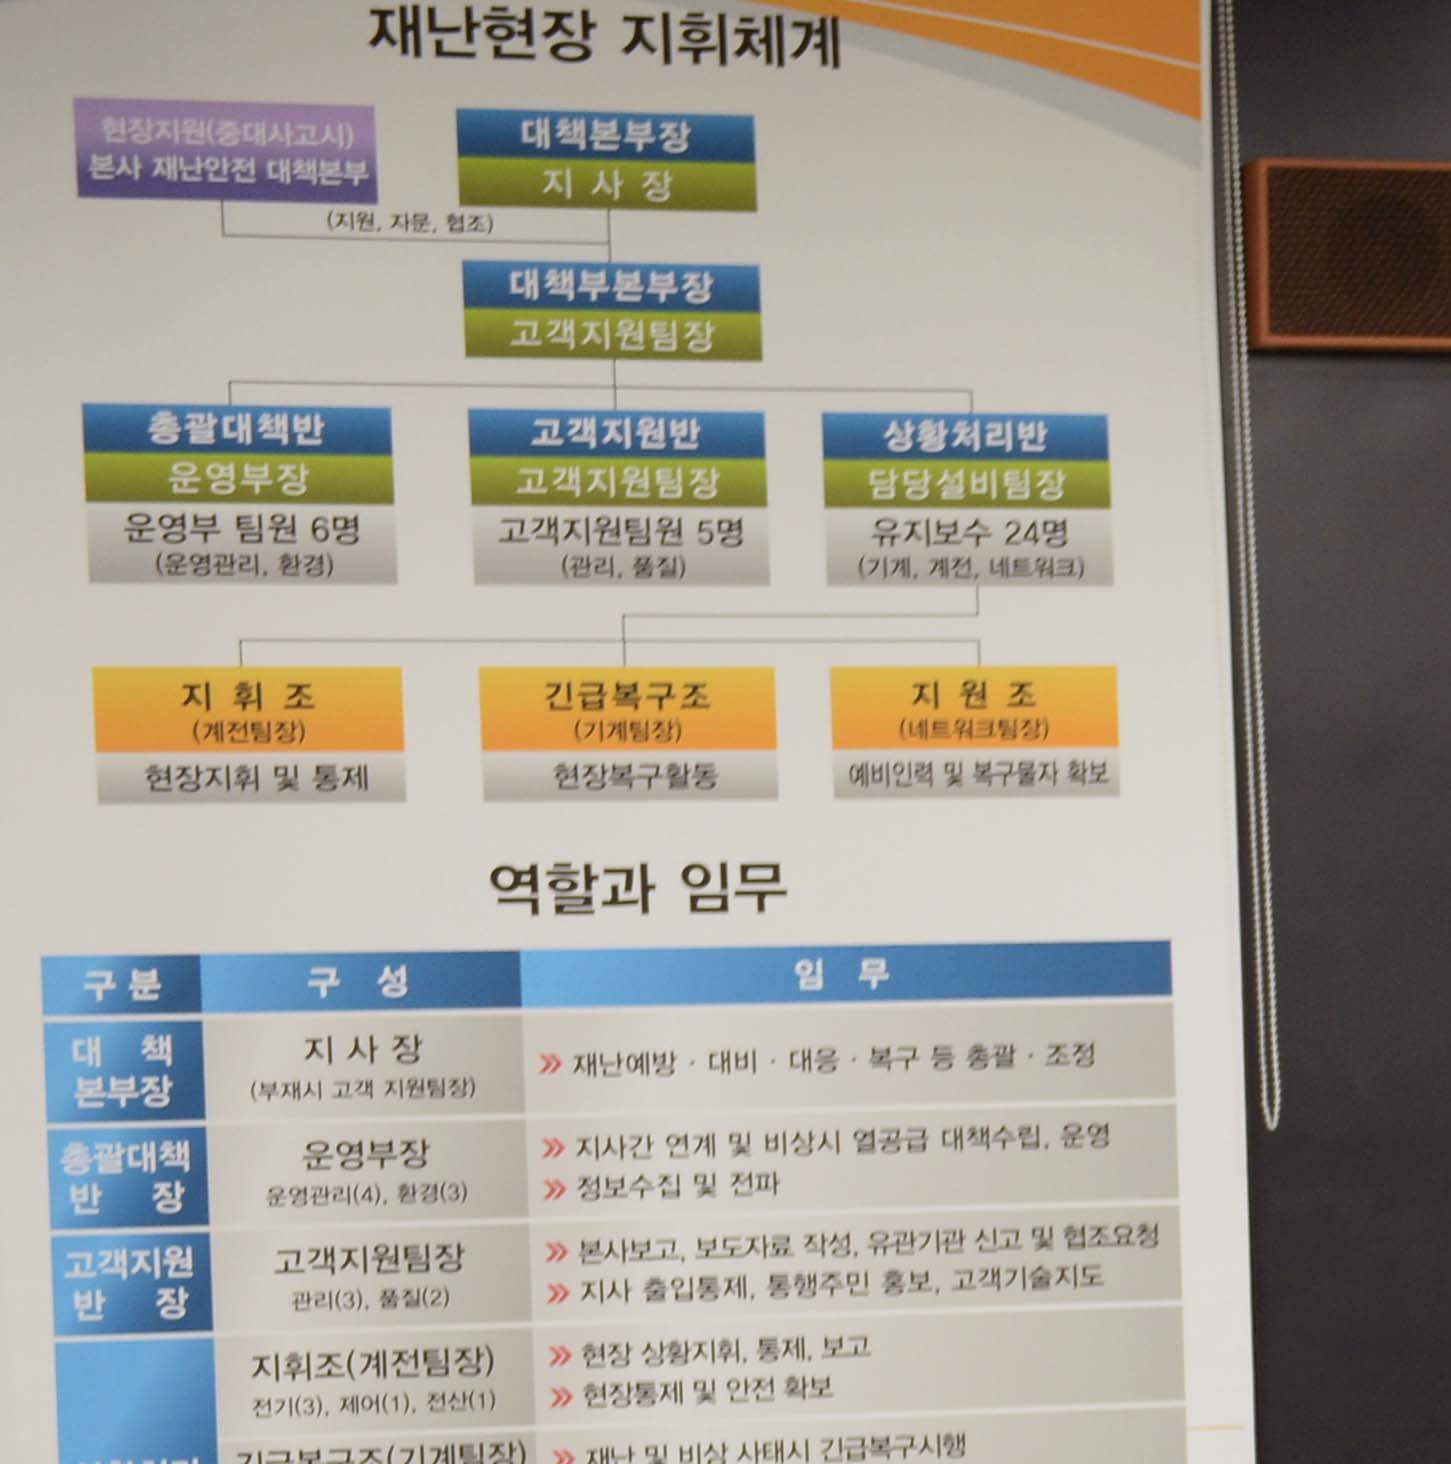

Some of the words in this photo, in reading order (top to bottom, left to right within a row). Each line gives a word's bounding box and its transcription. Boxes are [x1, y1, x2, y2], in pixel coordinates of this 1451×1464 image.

[369, 4, 597, 63] 재난현장
[622, 12, 840, 69] 지휘체계
[102, 117, 354, 151] 현장지원(중대사고시)
[522, 117, 691, 154] 대책본부장
[89, 154, 142, 181] 본사
[152, 155, 256, 183] 재난안전
[267, 158, 369, 186] 대책본부
[510, 268, 714, 304] 대책부본부장
[510, 319, 715, 353] 고객지원팀장
[148, 411, 325, 445] 총괄대책반
[531, 417, 700, 450] 고객지원반
[884, 419, 1048, 452] 상황처리반
[169, 462, 309, 496] 운영부장
[516, 466, 720, 500] 고객지원팀장
[869, 468, 1065, 501] 담당설비팀장
[124, 513, 220, 544] 운영부
[236, 513, 296, 544] 팀원
[311, 515, 359, 545] 6명
[499, 516, 682, 546] 고객지원팀원
[698, 518, 743, 548] 5명
[872, 518, 991, 548] 유지보수
[1005, 519, 1067, 548] 24명
[279, 552, 333, 577] 환경)
[858, 555, 918, 579] (기계,
[929, 557, 978, 579] 계전,
[990, 556, 1084, 579] 네트워크)
[546, 681, 710, 712] 긴급복구조
[193, 720, 305, 744] (계전팀장)
[574, 719, 681, 743] (기계팀장)
[899, 717, 1049, 741] (네트워크팀장)
[146, 764, 259, 792] 현장지휘
[274, 765, 298, 792] 및
[313, 765, 368, 792] 통제
[554, 762, 717, 790] 현장복구활동
[849, 761, 933, 788] 예비인력
[944, 761, 963, 787] 및
[973, 760, 1058, 787] 복구물자
[1068, 759, 1109, 786] 확보
[490, 863, 656, 916] 역할과
[681, 862, 787, 914] 임무
[574, 1051, 675, 1077] 재난예방
[709, 1050, 756, 1074] 대비
[790, 1048, 839, 1073] 대응
[870, 1046, 919, 1072] 복구
[931, 1045, 954, 1071] 등
[967, 1044, 1016, 1070] 총괄
[1046, 1042, 1095, 1068] 조정
[75, 1076, 172, 1109] 본부장
[251, 1080, 322, 1101] (부재시
[334, 1080, 373, 1099] 고객
[385, 1077, 475, 1098] 지원팀장)
[61, 1140, 191, 1175] 총괄대책
[304, 1138, 430, 1170] 운영부장
[577, 1135, 653, 1160] 지사간
[666, 1133, 716, 1158] 연계
[729, 1132, 750, 1157] 및
[765, 1130, 840, 1156] 비상시
[853, 1128, 928, 1154] 열공급
[942, 1124, 1049, 1152] 대책수립,
[1062, 1123, 1109, 1148] 운영
[578, 1174, 680, 1201] 정보수집
[694, 1172, 716, 1198] 및
[731, 1171, 779, 1196] 전파
[275, 1242, 465, 1275] 고객지원팀장
[579, 1239, 685, 1264] 본사보고,
[696, 1235, 792, 1259] 보도자료
[869, 1228, 966, 1256] 유관기관
[975, 1227, 1022, 1253] 신고
[1032, 1226, 1053, 1251] 및
[1064, 1222, 1159, 1250] 협조요청
[64, 1245, 193, 1280] 고객지원
[293, 1289, 369, 1311] 관리(3),
[380, 1286, 449, 1309] 품질(2)
[581, 1279, 629, 1304] 지사
[644, 1275, 754, 1302] 출입통제,
[769, 1271, 868, 1299] 통행주민
[883, 1269, 940, 1296] 홍보,
[952, 1264, 1104, 1291] 고객기술지도
[253, 1345, 494, 1382] 지휘조(계전팀장)
[582, 1342, 631, 1368] 현장
[642, 1339, 747, 1367] 상황지휘,
[758, 1336, 811, 1362] 통제,
[823, 1336, 870, 1358] 보고
[253, 1396, 329, 1418] 전기(3),
[340, 1392, 416, 1415] 제어(1),
[428, 1389, 495, 1412] 전산(1)
[584, 1381, 683, 1408] 현장통제
[693, 1379, 715, 1404] 및
[726, 1376, 774, 1402] 안전
[786, 1376, 832, 1400] 확보
[737, 1439, 809, 1464] 사태시
[822, 1432, 966, 1462] 긴급복구시행
